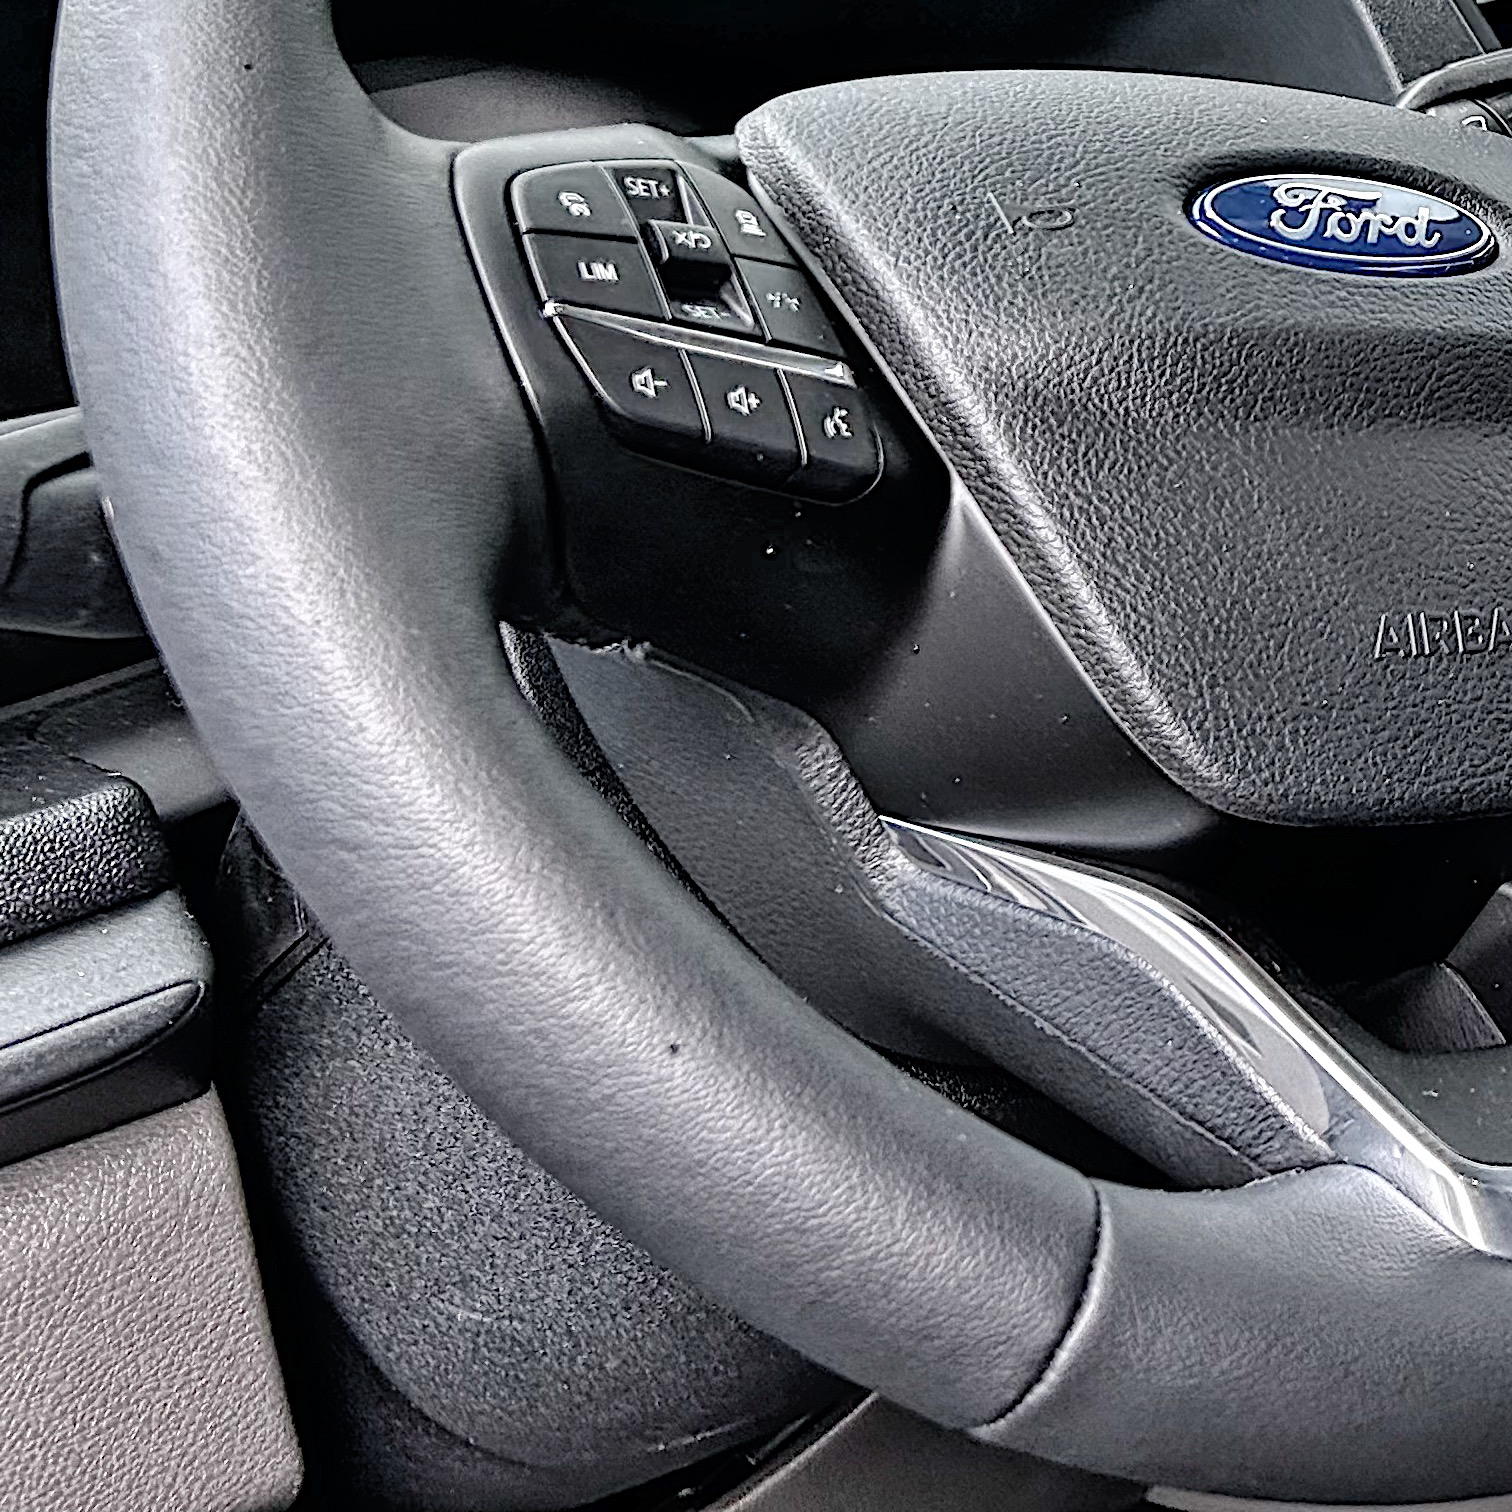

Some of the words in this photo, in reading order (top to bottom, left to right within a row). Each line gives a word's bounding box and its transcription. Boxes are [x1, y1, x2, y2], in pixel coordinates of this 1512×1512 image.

[623, 176, 671, 199] SET+
[1268, 182, 1441, 250] Ford
[578, 260, 620, 283] LIM
